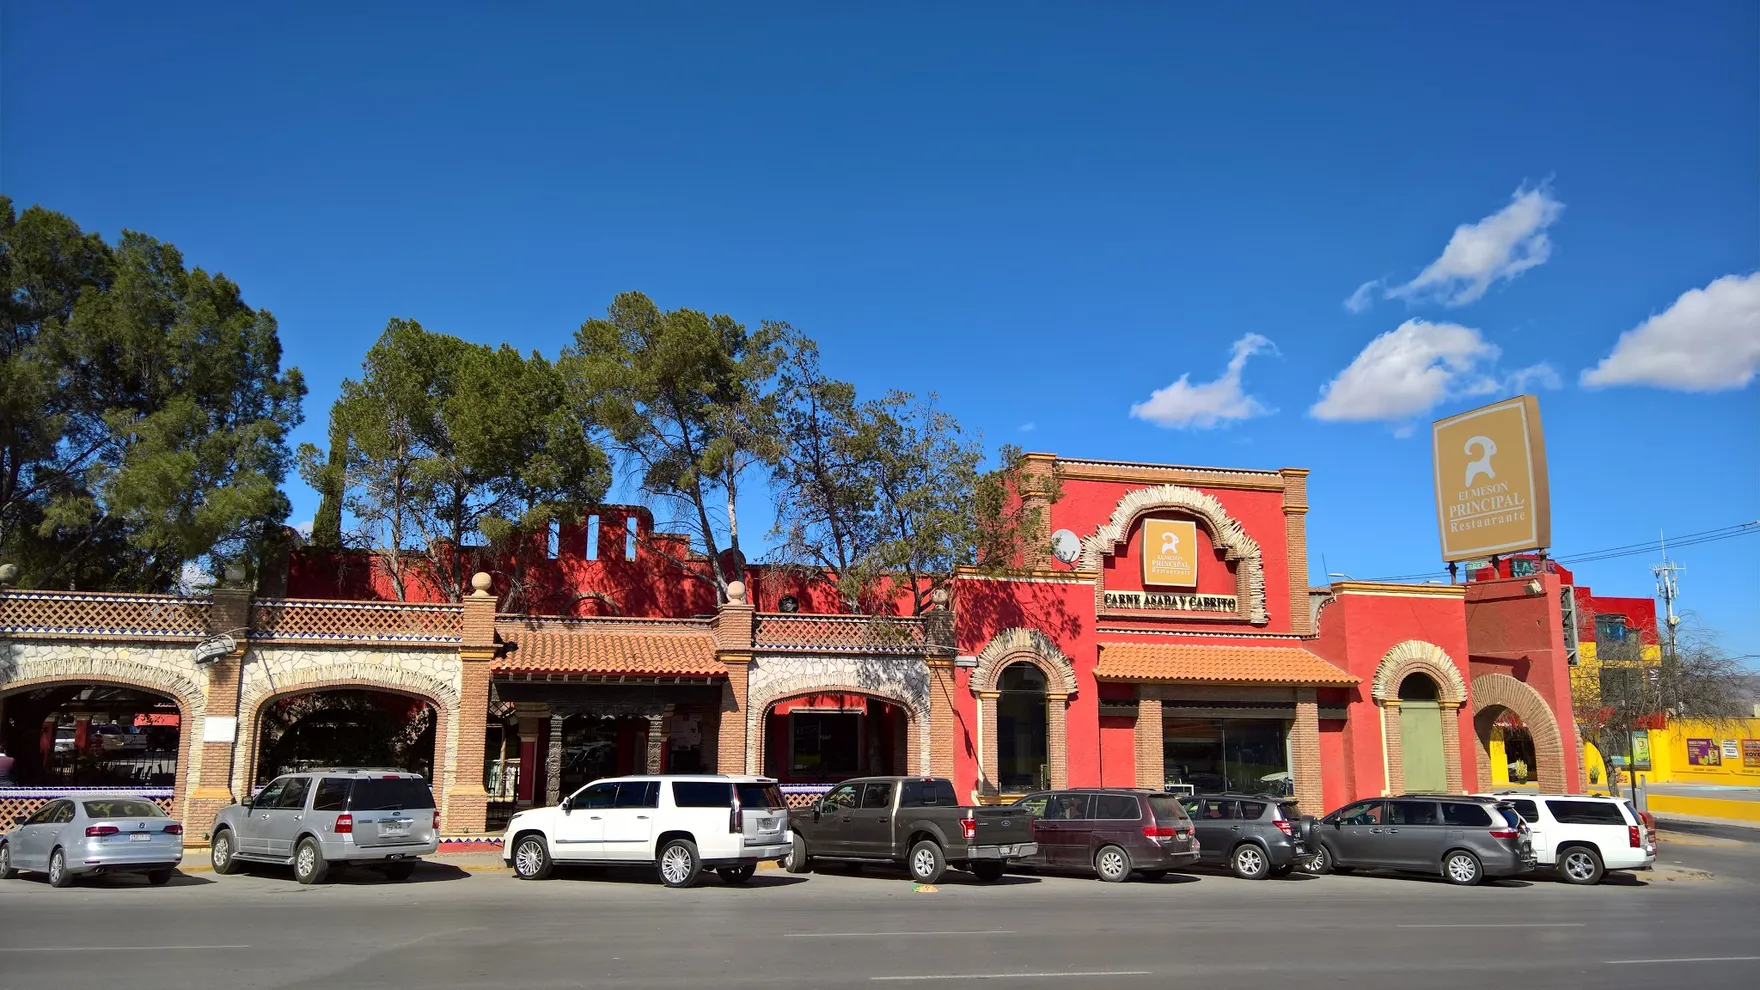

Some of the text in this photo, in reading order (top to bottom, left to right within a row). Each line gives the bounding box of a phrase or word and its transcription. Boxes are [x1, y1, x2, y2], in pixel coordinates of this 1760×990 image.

[1458, 482, 1509, 501] EL MESON
[1450, 492, 1525, 518] PRINCIPAL
[1450, 511, 1526, 533] Restaurante
[1152, 560, 1189, 568] PRINCIPAL
[1104, 593, 1237, 609] CARNE ASADA Y CABRITO
